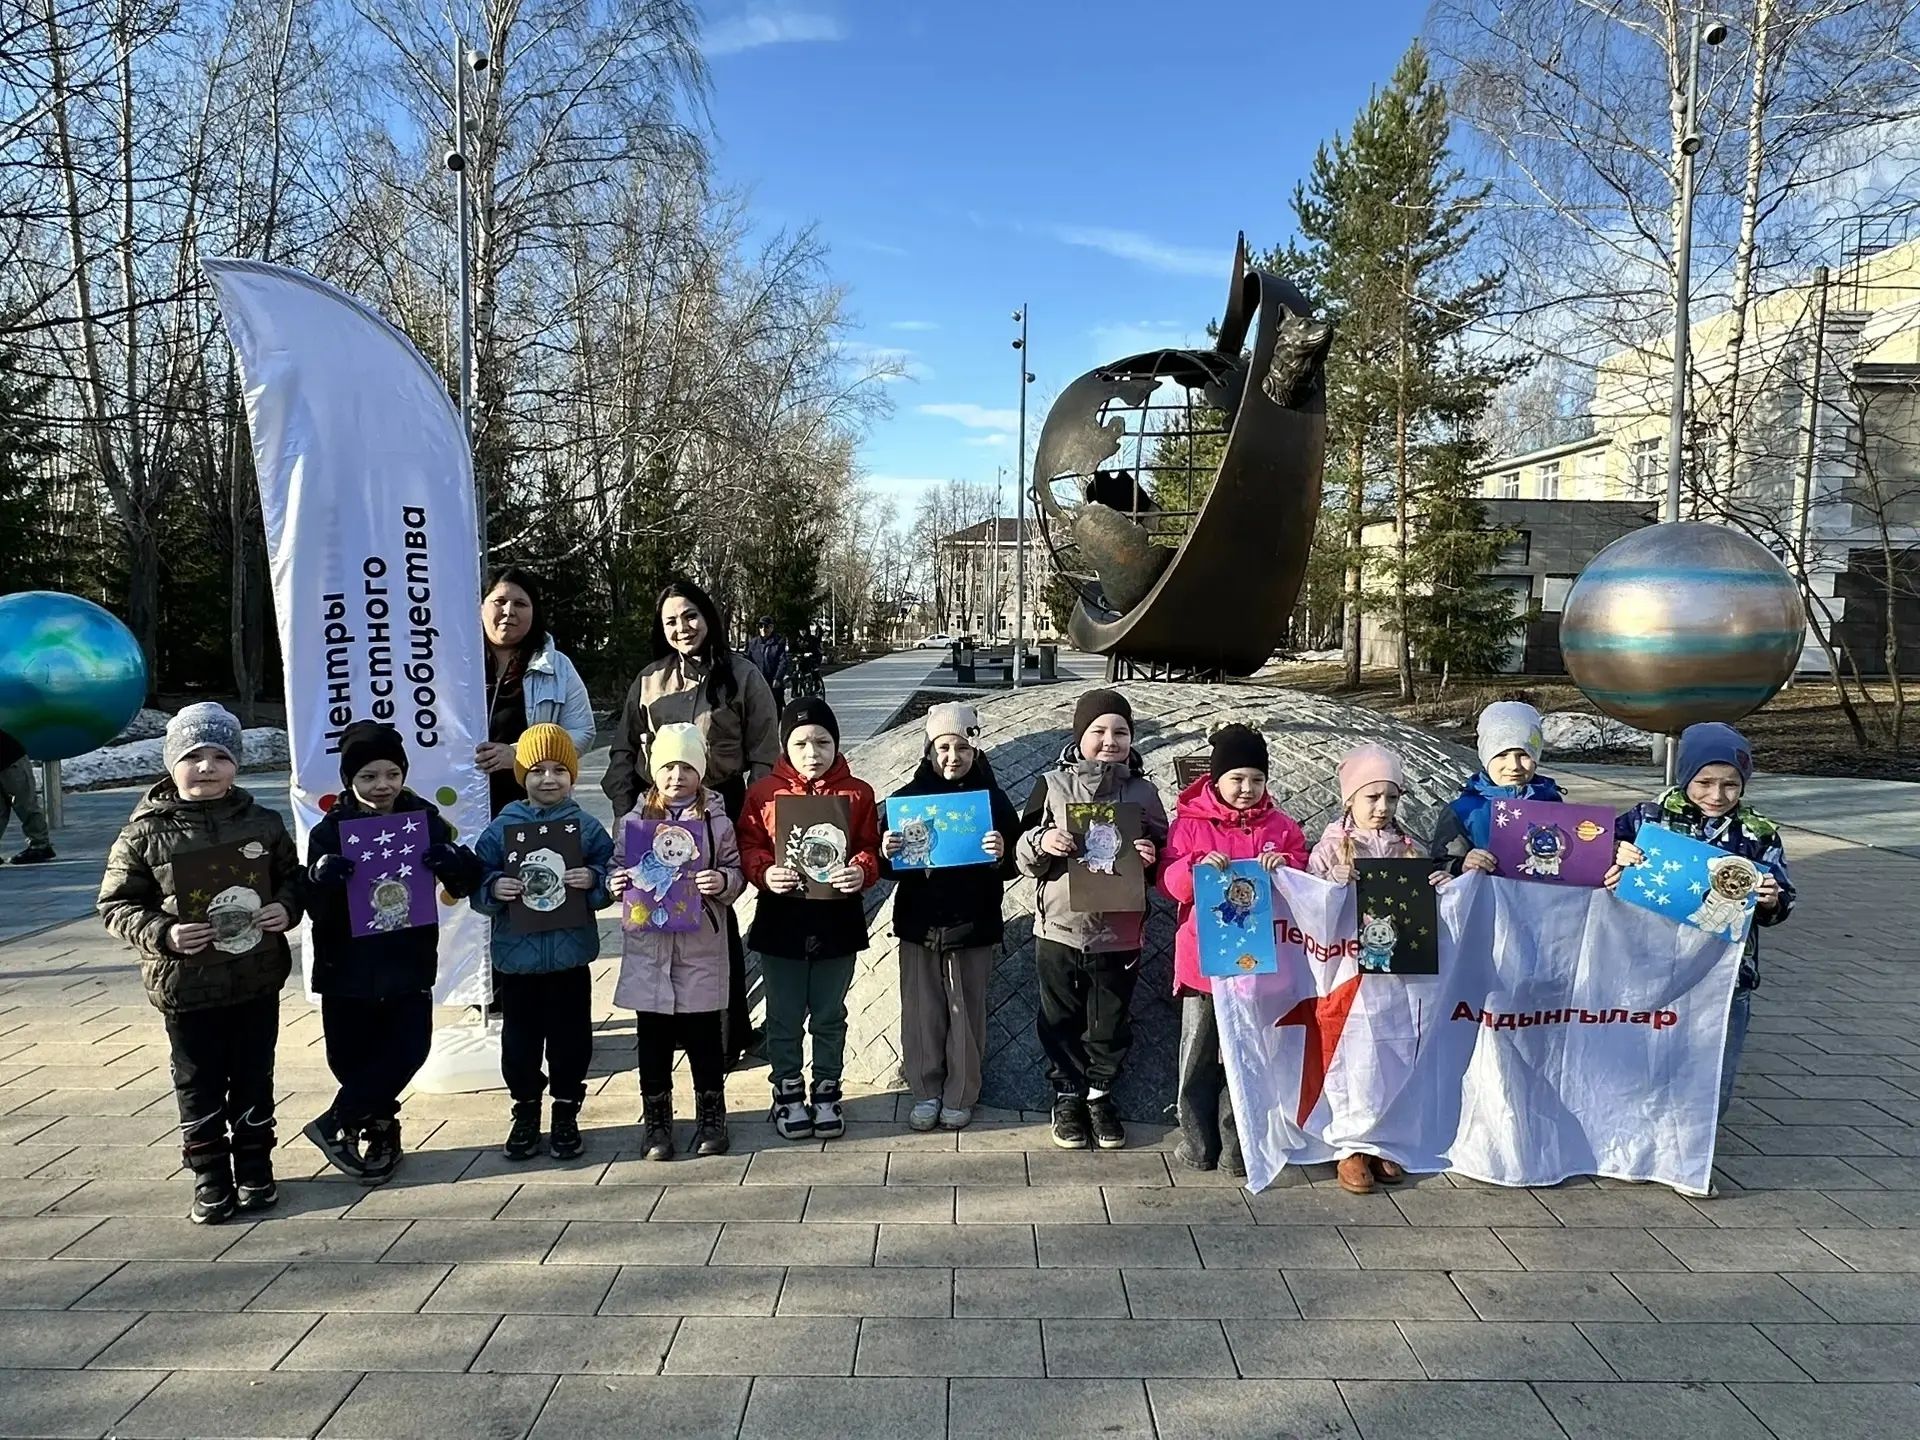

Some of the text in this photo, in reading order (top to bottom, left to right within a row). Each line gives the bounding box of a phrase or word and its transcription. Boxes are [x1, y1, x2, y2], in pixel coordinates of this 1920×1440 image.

[363, 556, 395, 728] естного
[402, 505, 440, 748] сообщества
[1272, 919, 1359, 962] Первые
[1450, 1001, 1678, 1030] Алдынгылар
